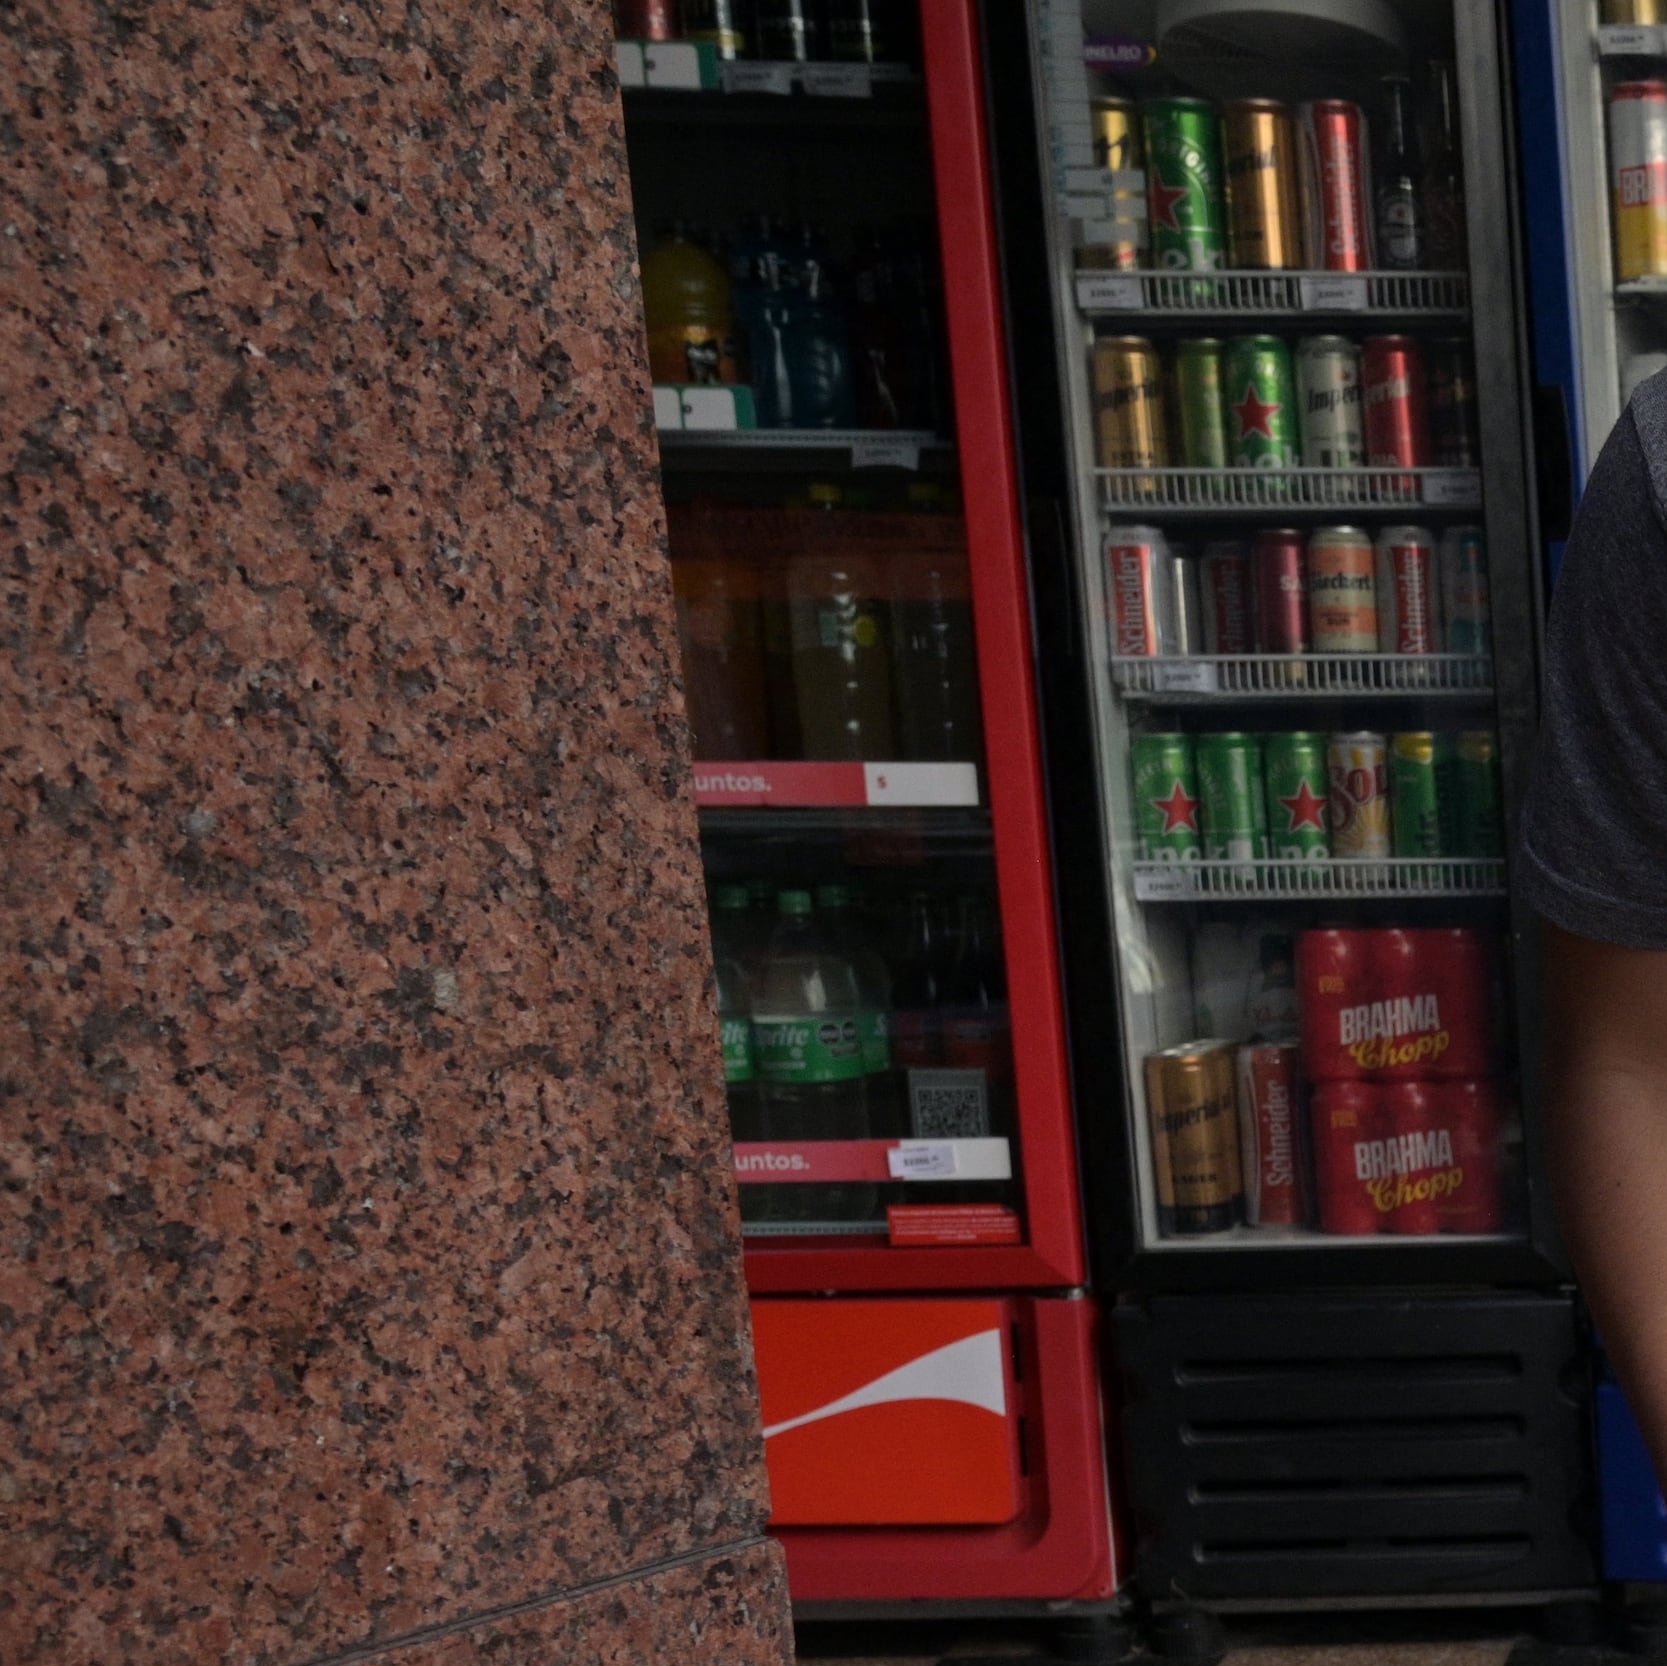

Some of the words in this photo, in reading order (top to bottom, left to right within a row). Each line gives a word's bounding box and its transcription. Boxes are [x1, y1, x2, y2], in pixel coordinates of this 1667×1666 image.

[1119, 550, 1144, 655] Schneider
[693, 773, 772, 791] untos.
[1339, 994, 1440, 1045] BRAHMA
[1349, 1030, 1450, 1070] Chopp
[1266, 1080, 1293, 1186] Schneider
[1354, 1129, 1453, 1180] BRAHMA
[734, 1152, 810, 1170] untos.
[1366, 1167, 1464, 1213] Chopp
